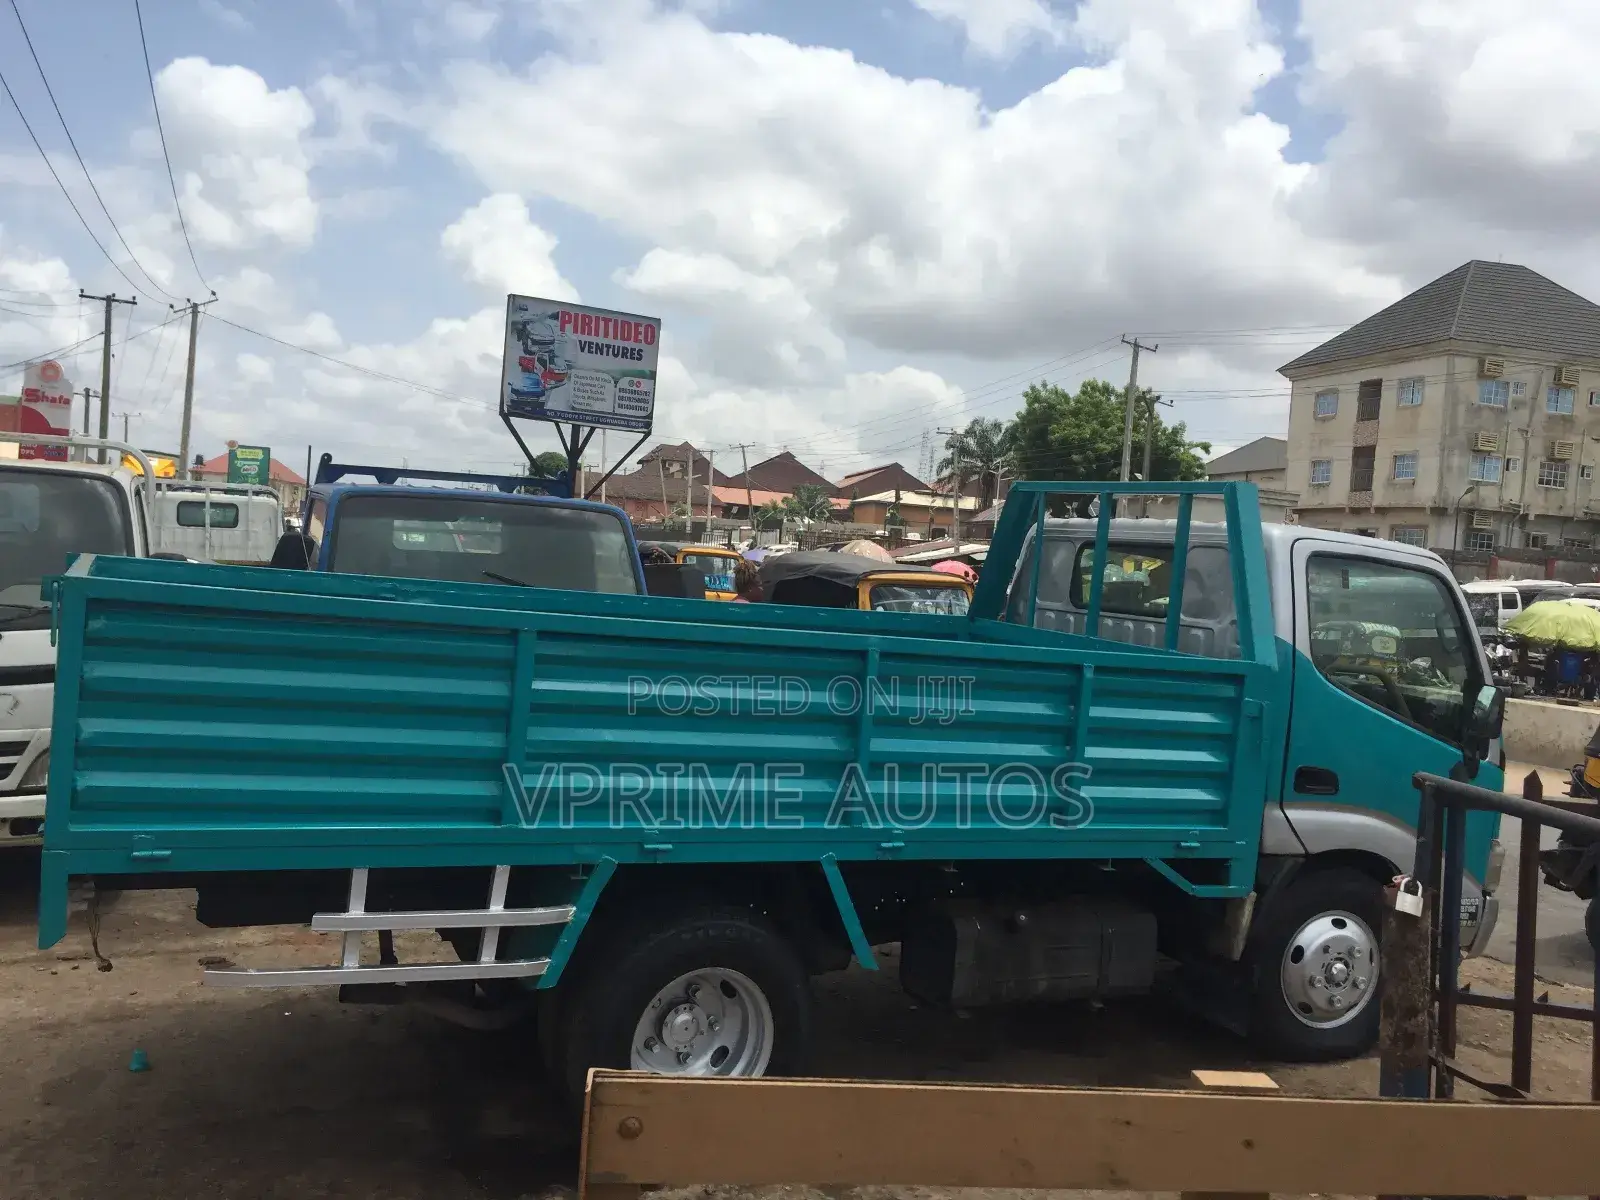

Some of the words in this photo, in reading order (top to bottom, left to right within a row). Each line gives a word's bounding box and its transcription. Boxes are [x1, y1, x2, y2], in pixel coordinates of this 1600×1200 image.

[559, 311, 656, 345] PIRITIDEO
[578, 340, 644, 361] VENTURES
[24, 388, 70, 405] Shafa
